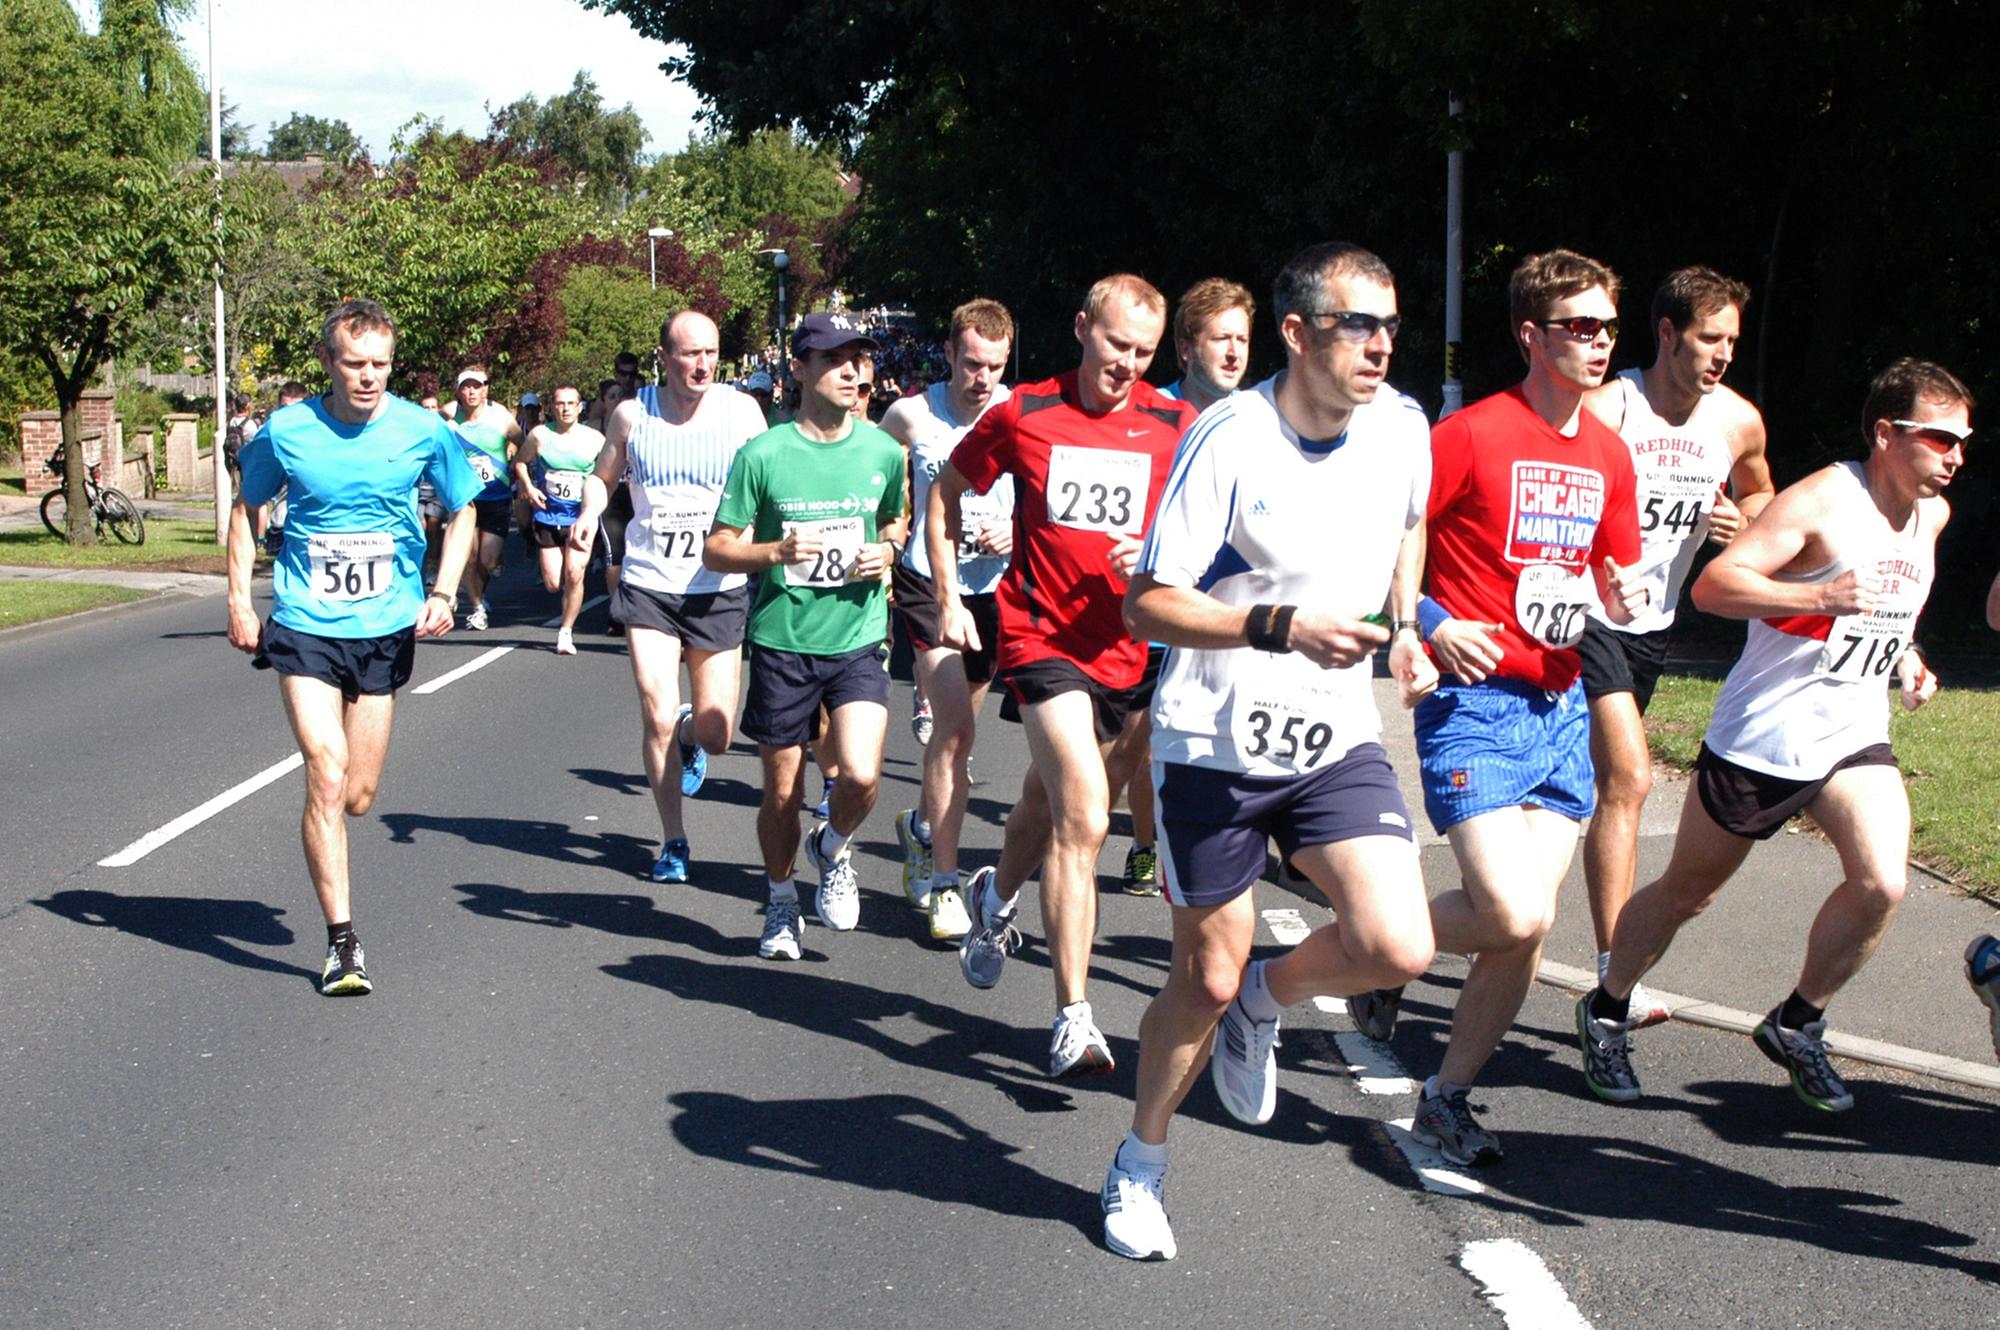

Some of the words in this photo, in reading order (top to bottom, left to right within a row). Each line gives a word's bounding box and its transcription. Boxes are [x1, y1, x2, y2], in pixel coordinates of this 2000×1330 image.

[1635, 438, 1705, 459] REDHILL
[554, 483, 571, 498] 56
[1519, 468, 1546, 482] BANK
[1550, 469, 1561, 483] OF
[1670, 474, 1714, 485] RUNNING
[1060, 481, 1132, 526] 233
[1519, 482, 1604, 521] CHICAGO
[1641, 498, 1703, 534] 544
[818, 522, 857, 534] UNNING
[324, 561, 375, 595] 561
[808, 548, 844, 583] 28
[1830, 634, 1900, 677] 718
[1244, 710, 1333, 768] 359
